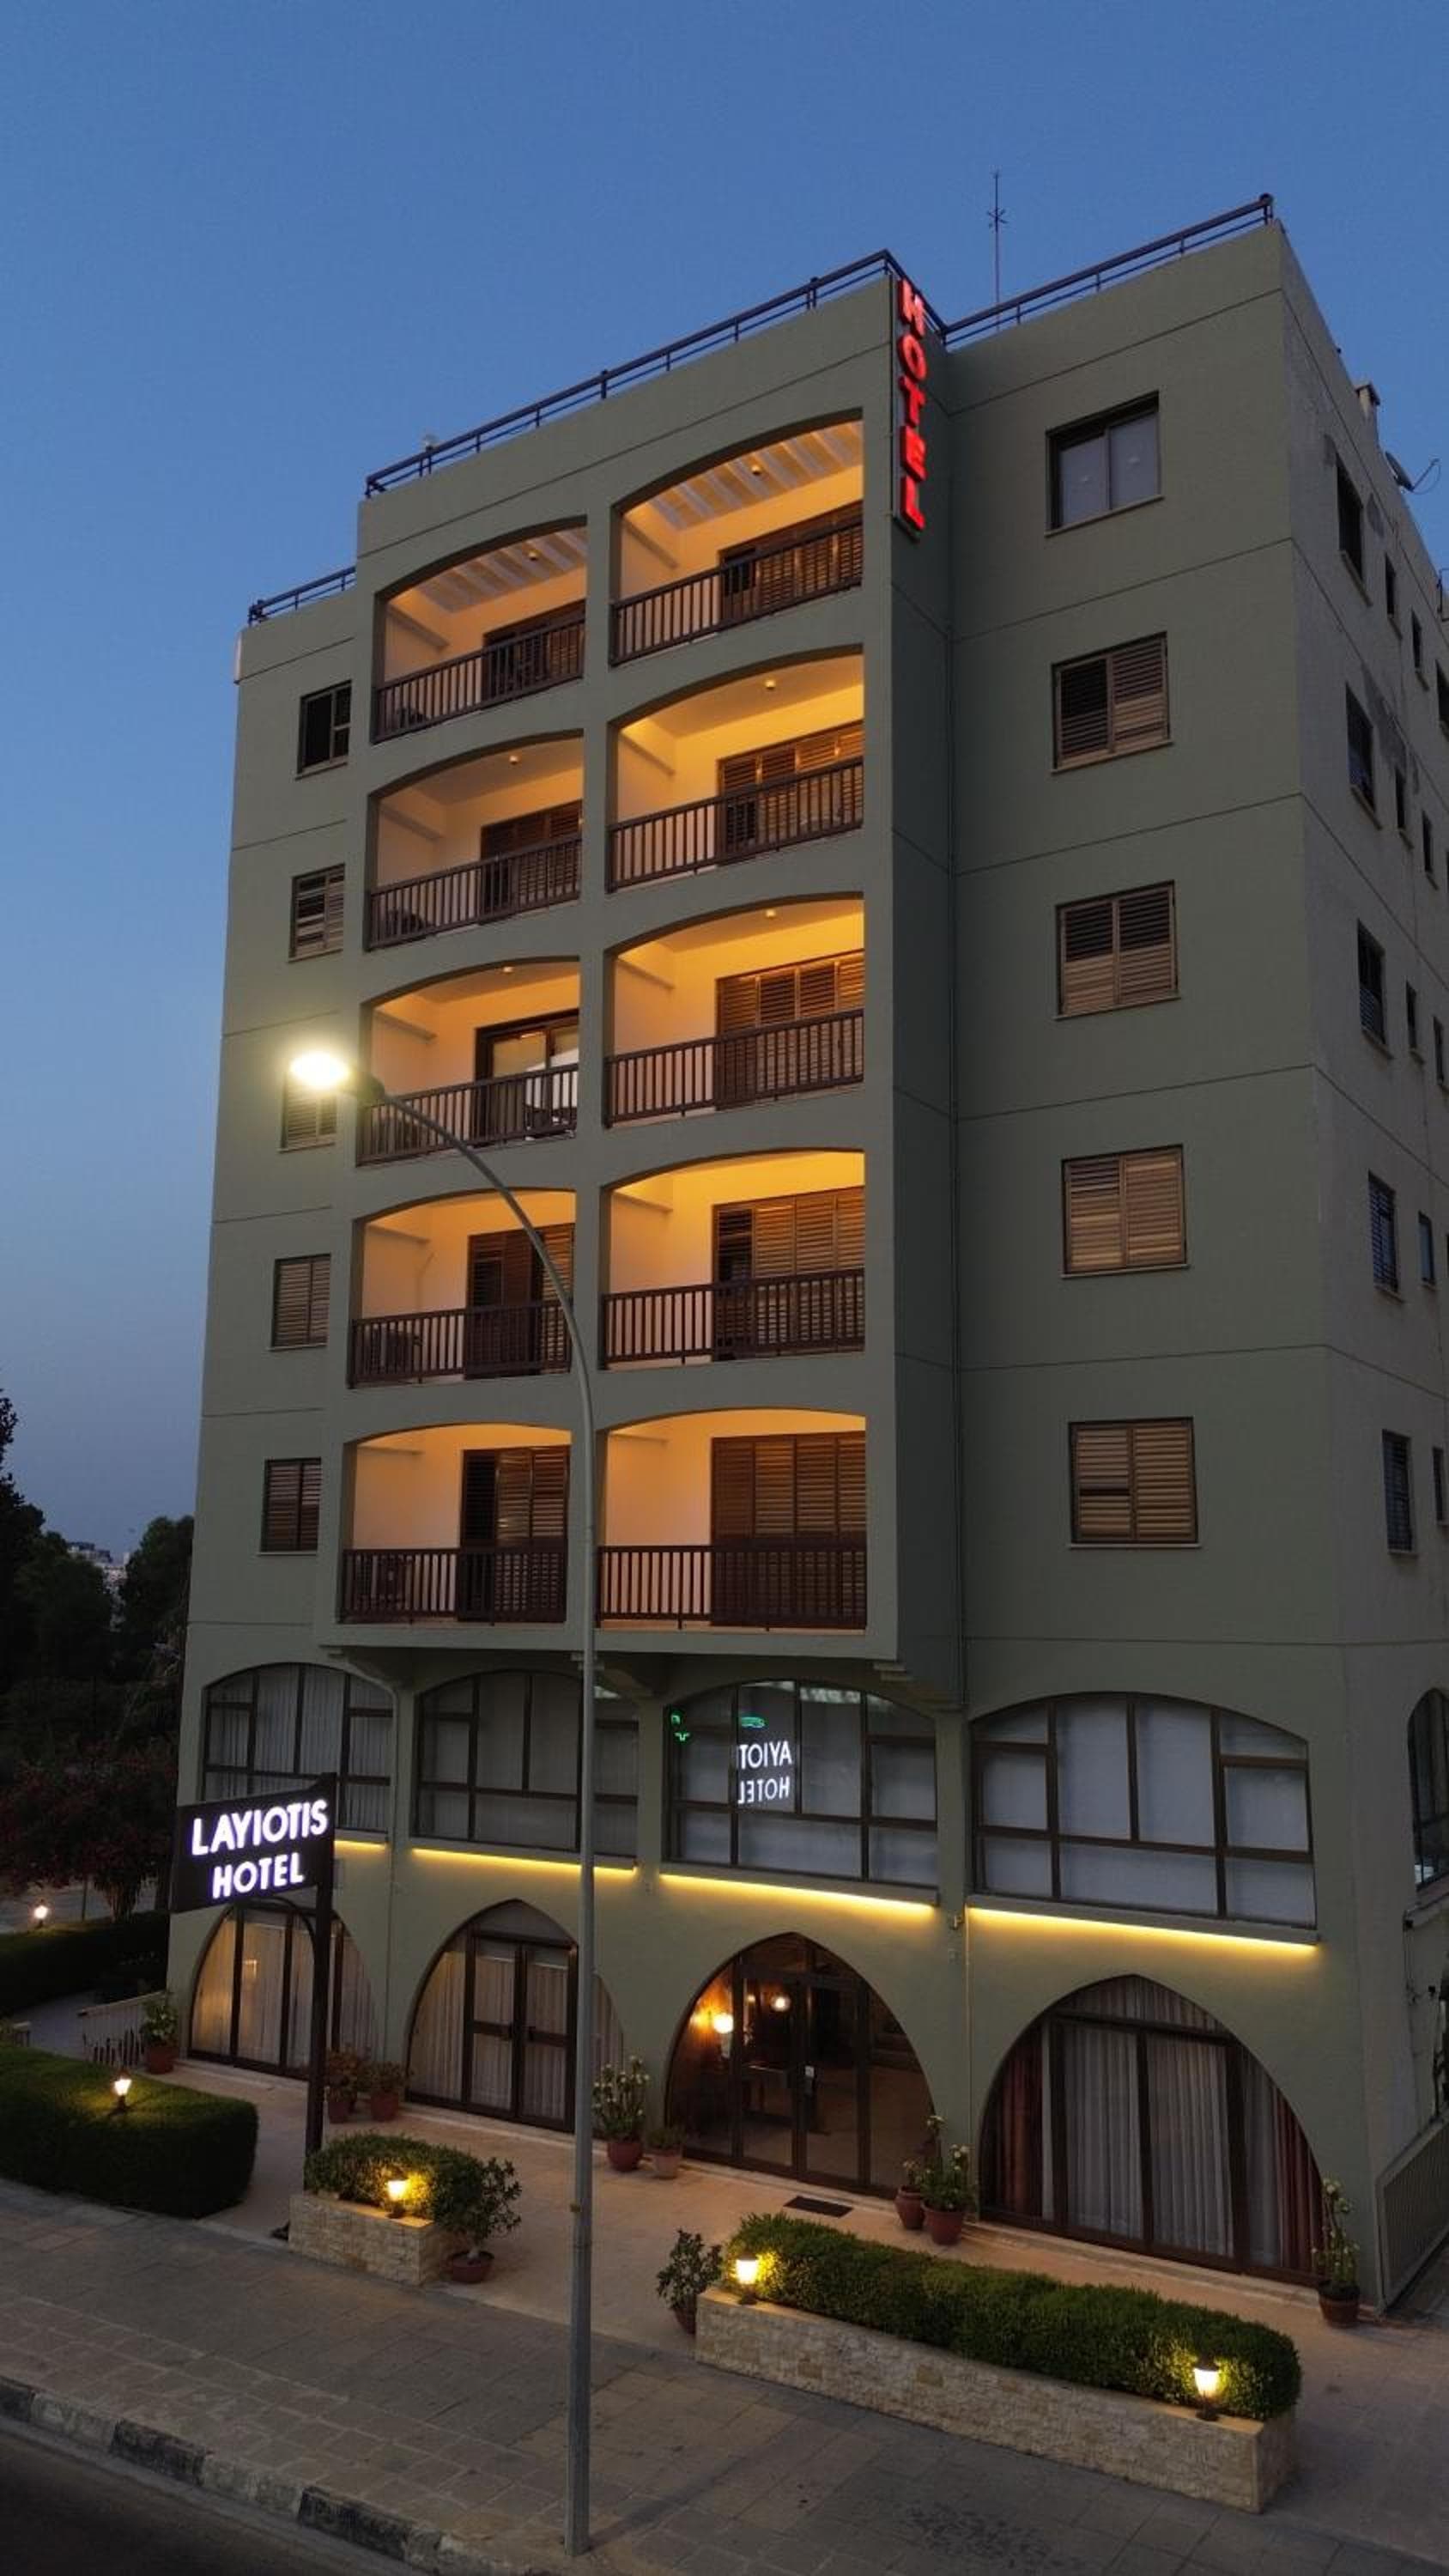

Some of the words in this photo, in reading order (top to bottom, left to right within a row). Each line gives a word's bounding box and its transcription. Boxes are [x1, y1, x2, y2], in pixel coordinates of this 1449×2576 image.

[898, 277, 928, 532] HOTEL
[191, 1799, 328, 1856] LAYIOTIS
[212, 1852, 305, 1899] HOTEL
